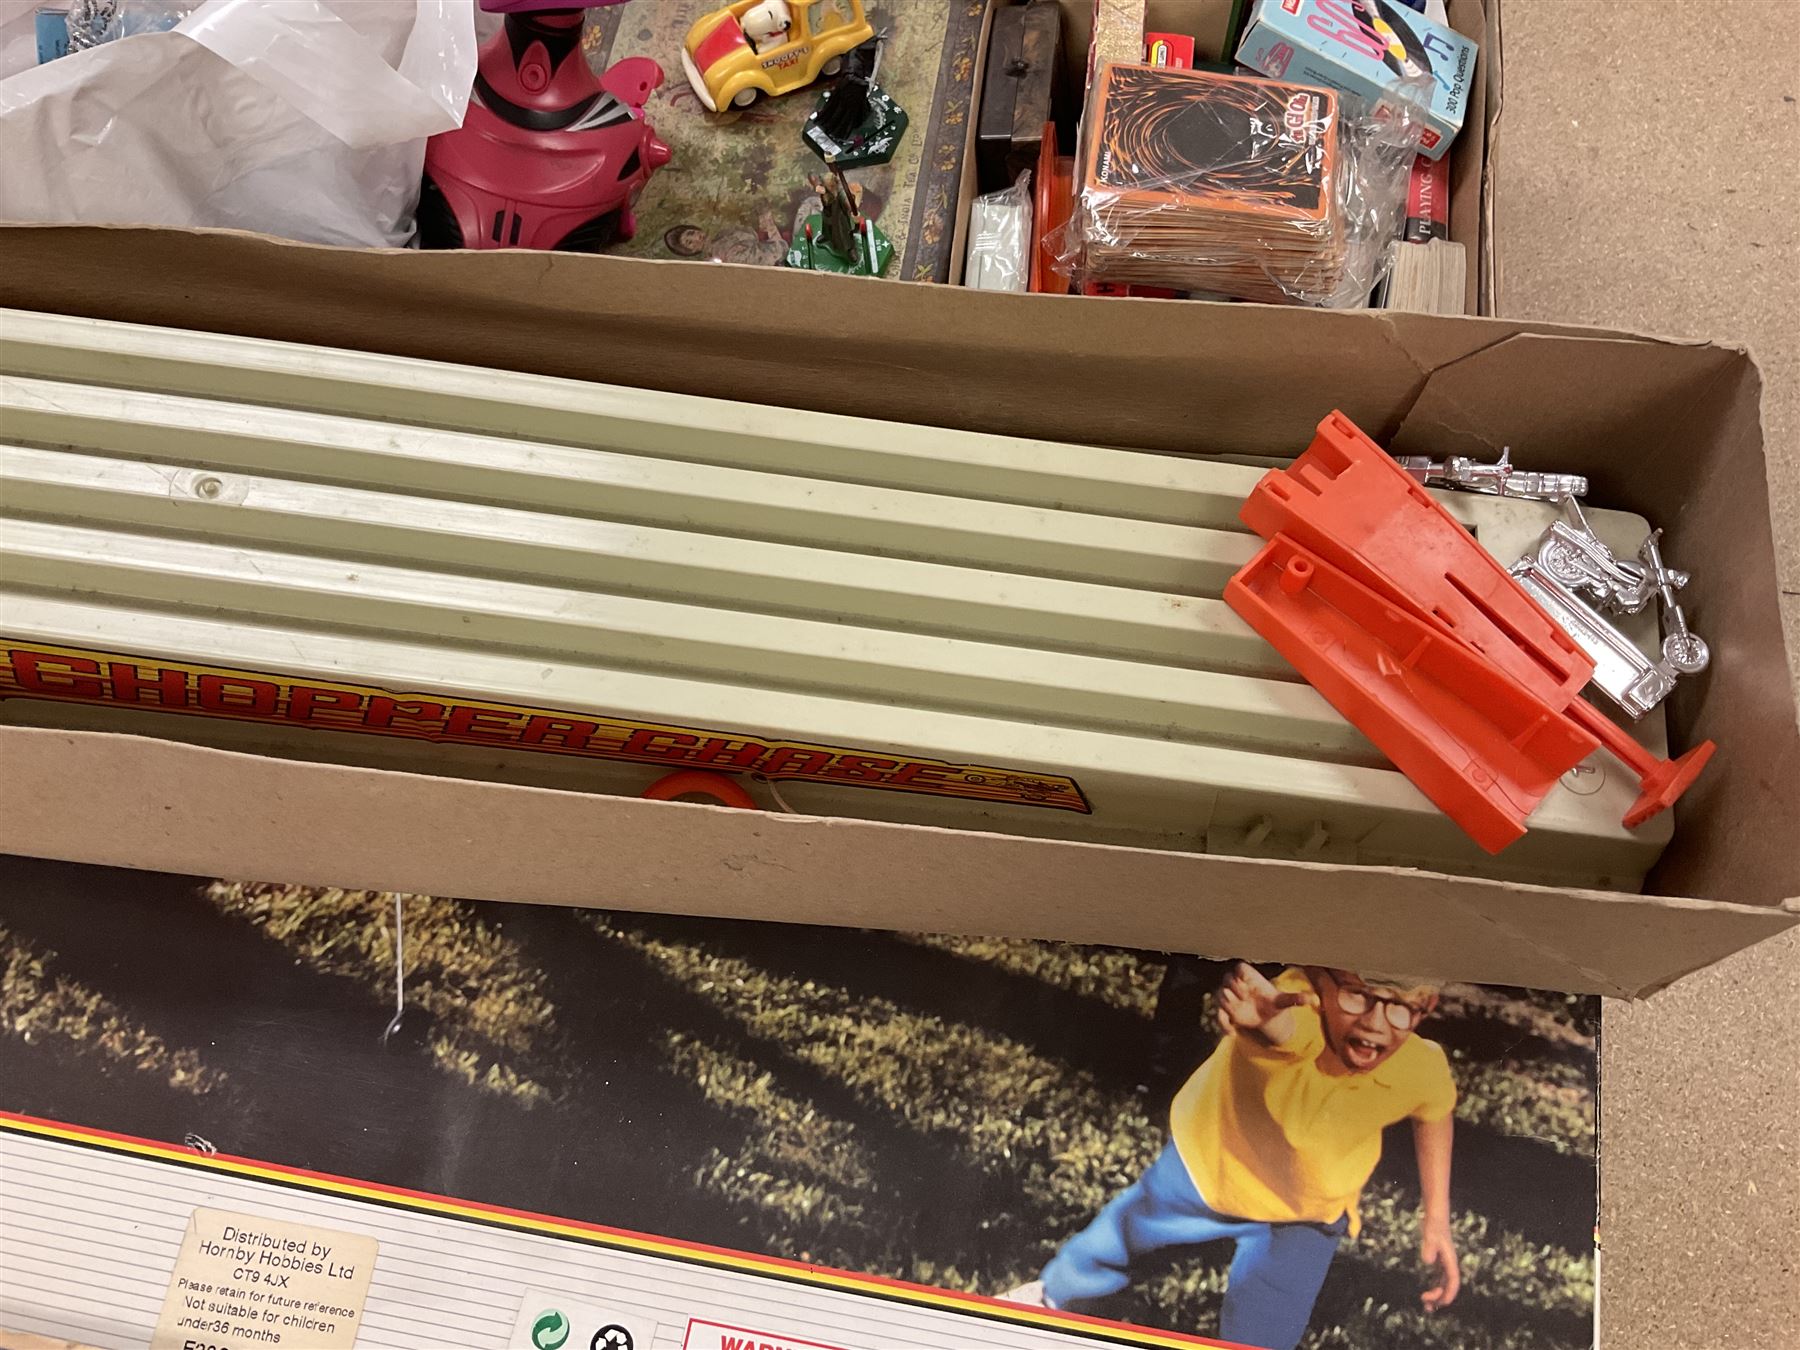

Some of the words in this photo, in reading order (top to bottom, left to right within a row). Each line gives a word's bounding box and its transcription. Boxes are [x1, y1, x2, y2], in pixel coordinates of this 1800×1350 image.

[1453, 45, 1470, 83] Questions
[1446, 97, 1458, 115] 300
[1450, 83, 1464, 99] Pop
[1100, 151, 1112, 183] KONAMI
[1418, 173, 1433, 235] PLAYING
[9, 648, 599, 752] CHOPPER
[621, 727, 968, 791] CHASE
[199, 1240, 256, 1265] Hornby
[259, 1250, 324, 1274] Hobbies
[328, 1262, 355, 1280] Ltd
[223, 1226, 308, 1254] Distributed
[311, 1241, 332, 1261] by
[232, 1267, 261, 1283] CT9
[263, 1274, 290, 1289] 4JX
[177, 1278, 213, 1294] Please
[215, 1285, 246, 1299] retain
[249, 1290, 266, 1304] for
[267, 1293, 301, 1309] future
[303, 1301, 355, 1319] reference
[185, 1296, 206, 1310] Not
[208, 1302, 259, 1320] suitable
[261, 1309, 279, 1323] for
[282, 1314, 336, 1334] children
[231, 1325, 281, 1344] months
